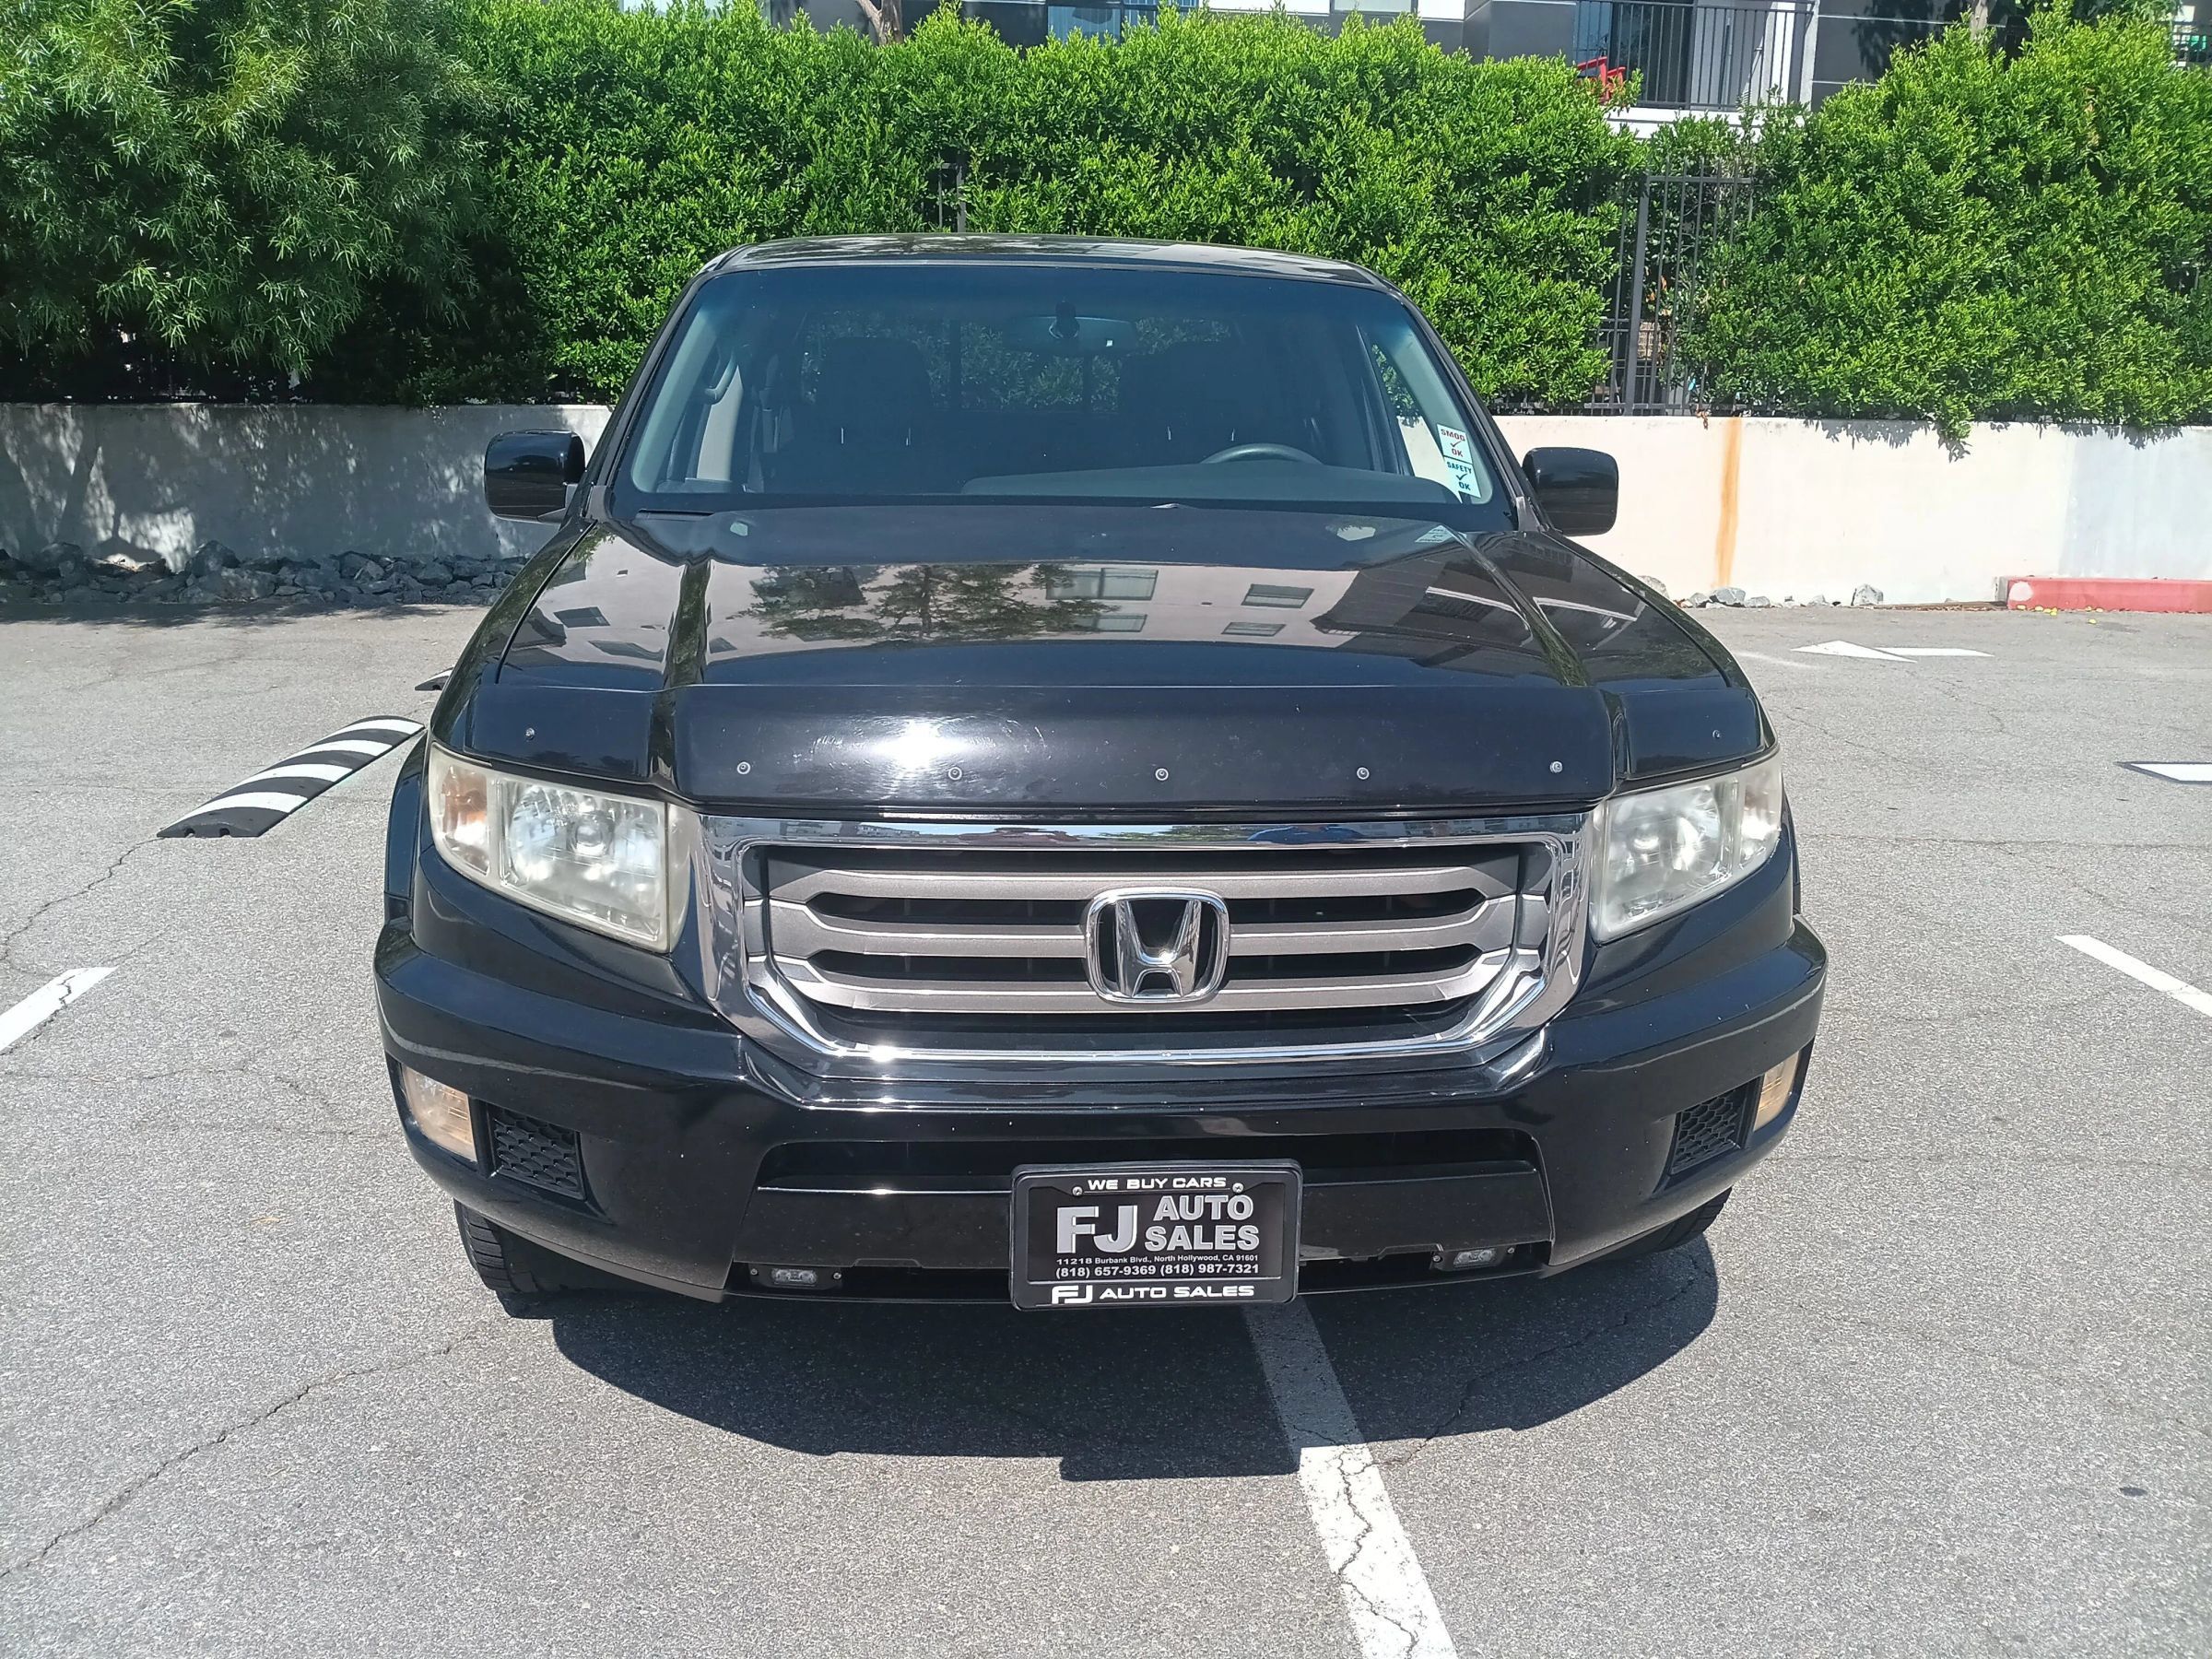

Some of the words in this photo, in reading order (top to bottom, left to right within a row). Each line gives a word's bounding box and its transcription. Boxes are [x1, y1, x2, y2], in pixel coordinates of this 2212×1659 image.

[1441, 429, 1465, 441] SMOG
[1452, 448, 1463, 457] OK
[1447, 461, 1471, 474] SAFETY
[1459, 481, 1470, 490] OK
[1088, 1179, 1118, 1190] WE
[1127, 1178, 1168, 1189] BUY
[1172, 1177, 1227, 1188] CARS
[1153, 1194, 1253, 1221] AUTO
[1056, 1206, 1137, 1253] FJ
[1145, 1225, 1260, 1251] SALES
[1130, 1255, 1152, 1264] Blvd.,
[1178, 1254, 1220, 1263] Hollywood,
[1056, 1266, 1089, 1278] (818)
[1094, 1265, 1156, 1277] 657-9369
[1160, 1265, 1194, 1277] (818)
[1198, 1264, 1259, 1274] 987-7321
[1052, 1285, 1092, 1304] FJ
[1100, 1288, 1166, 1300] AUTO
[1174, 1286, 1254, 1298] SALES
